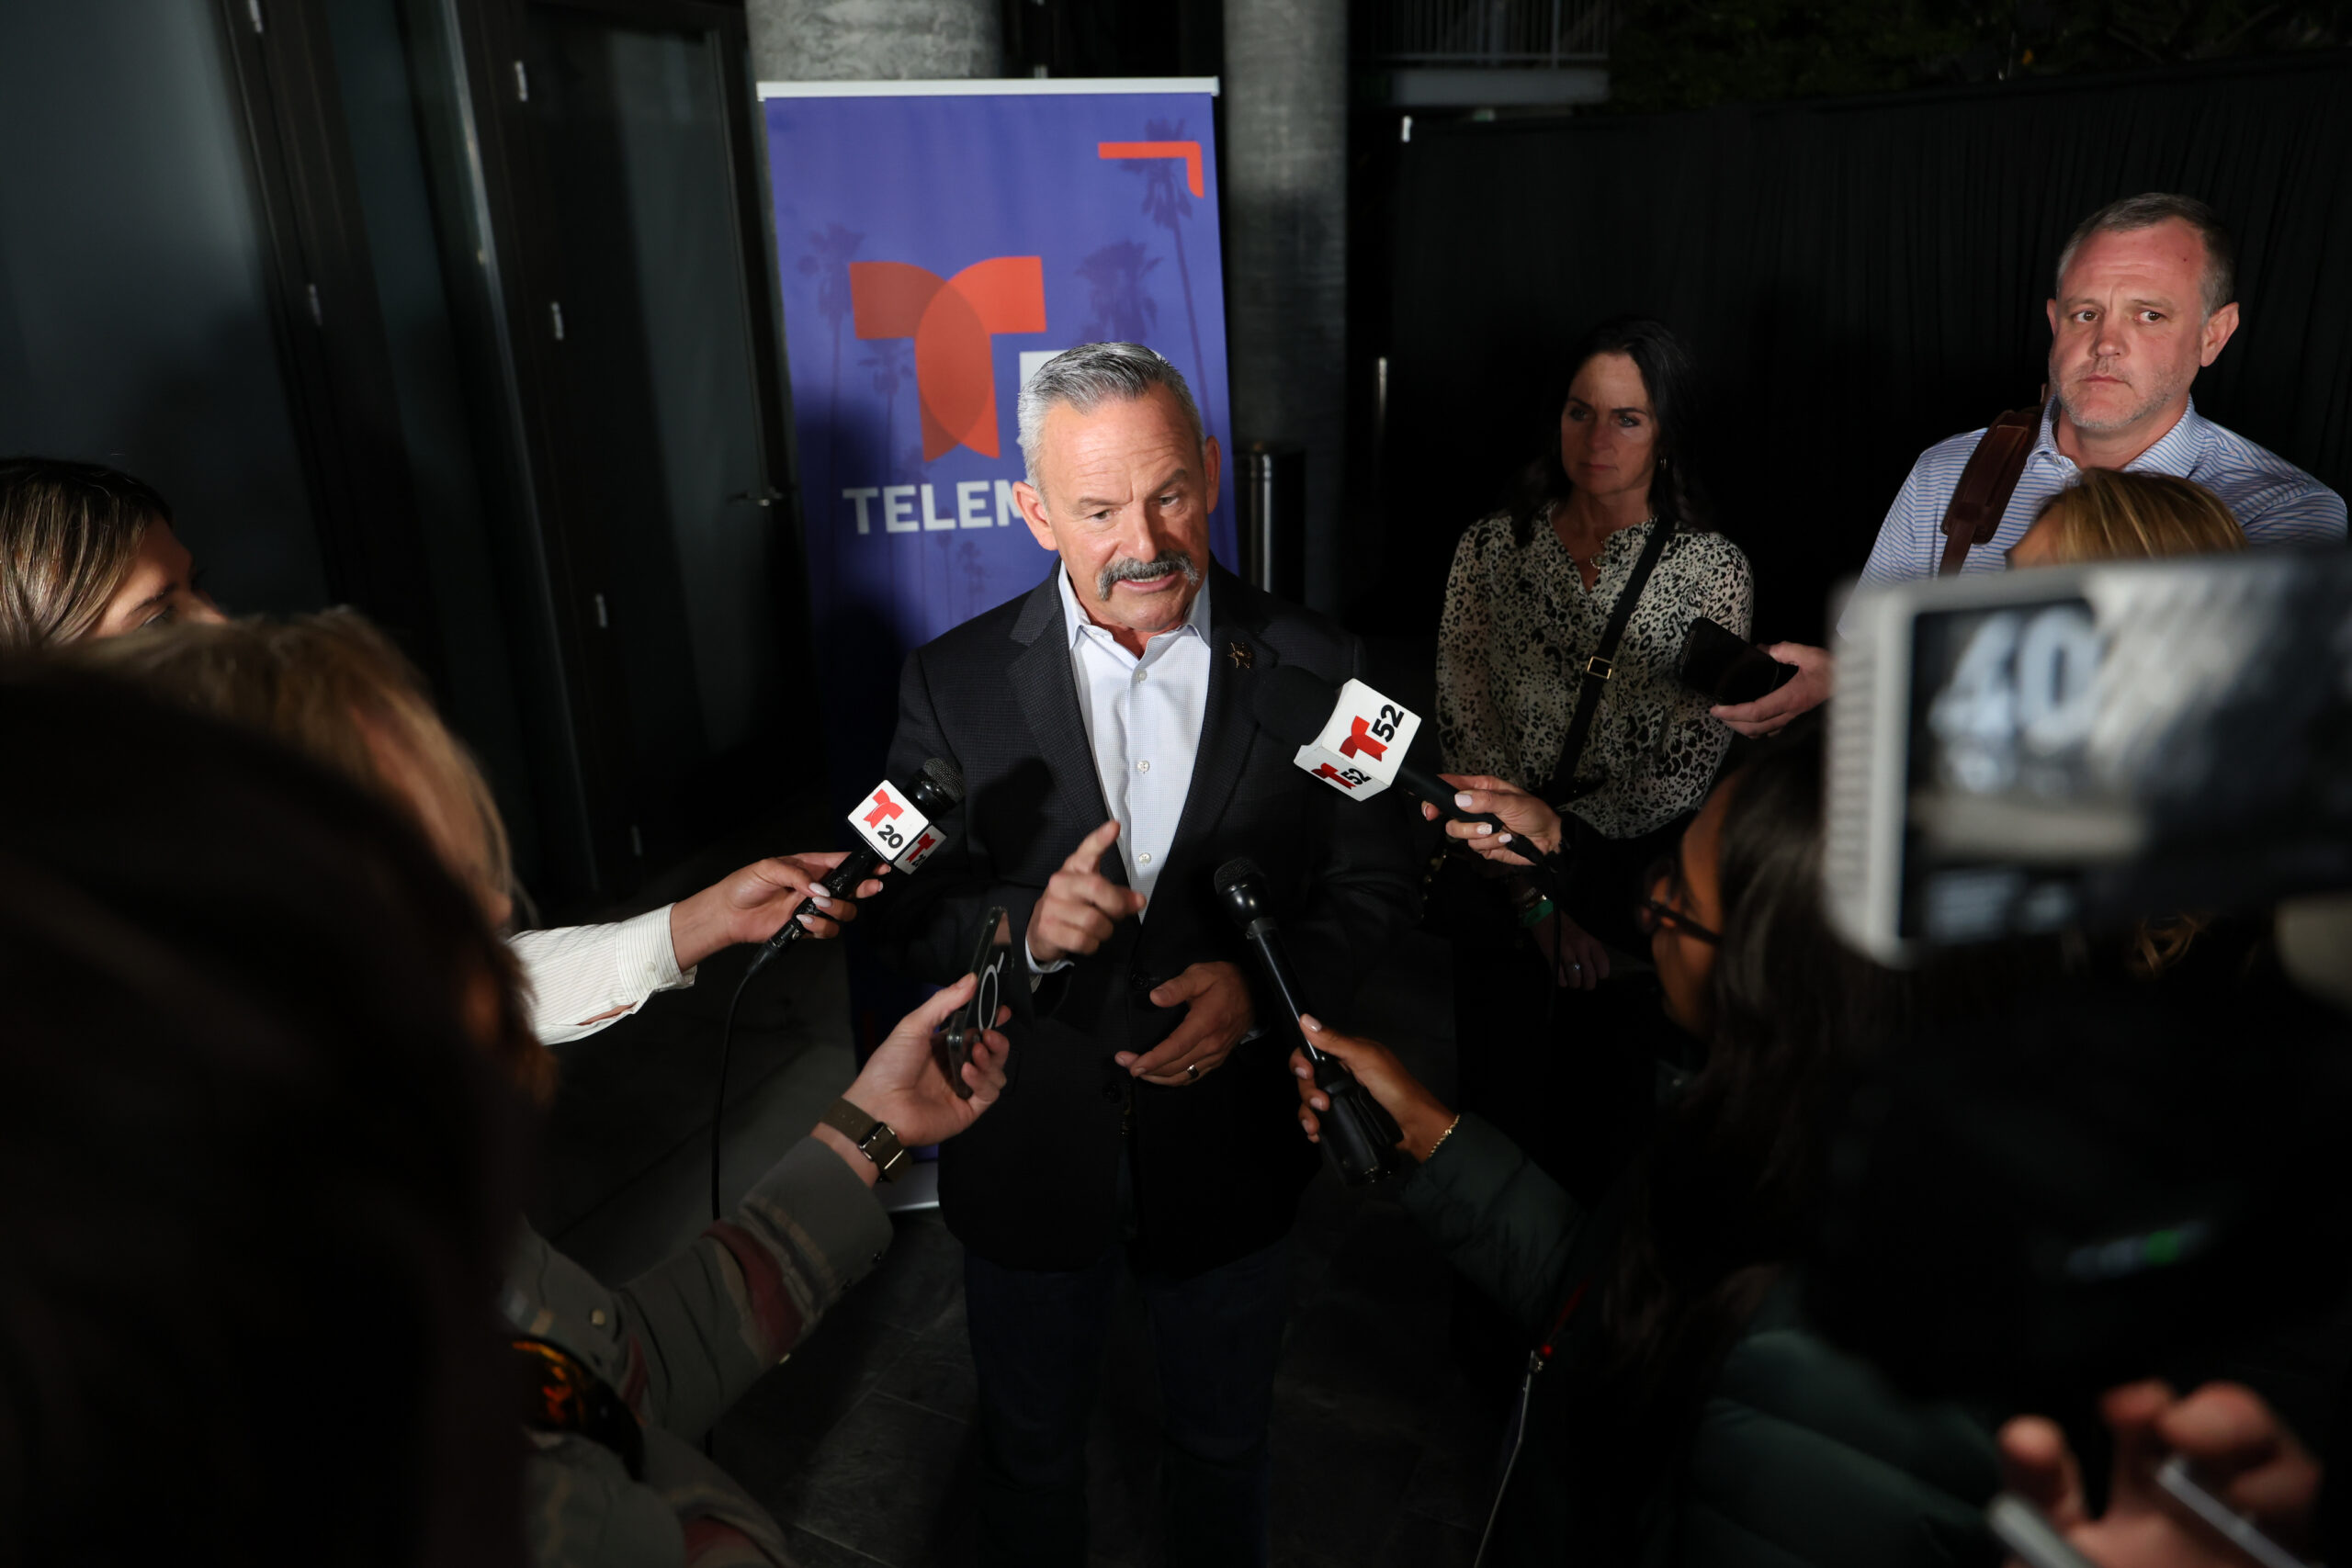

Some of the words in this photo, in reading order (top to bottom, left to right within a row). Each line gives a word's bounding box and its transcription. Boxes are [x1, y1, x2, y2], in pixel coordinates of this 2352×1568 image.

[1371, 704, 1405, 742] 52
[1340, 768, 1373, 785] 52
[876, 824, 904, 849] 20
